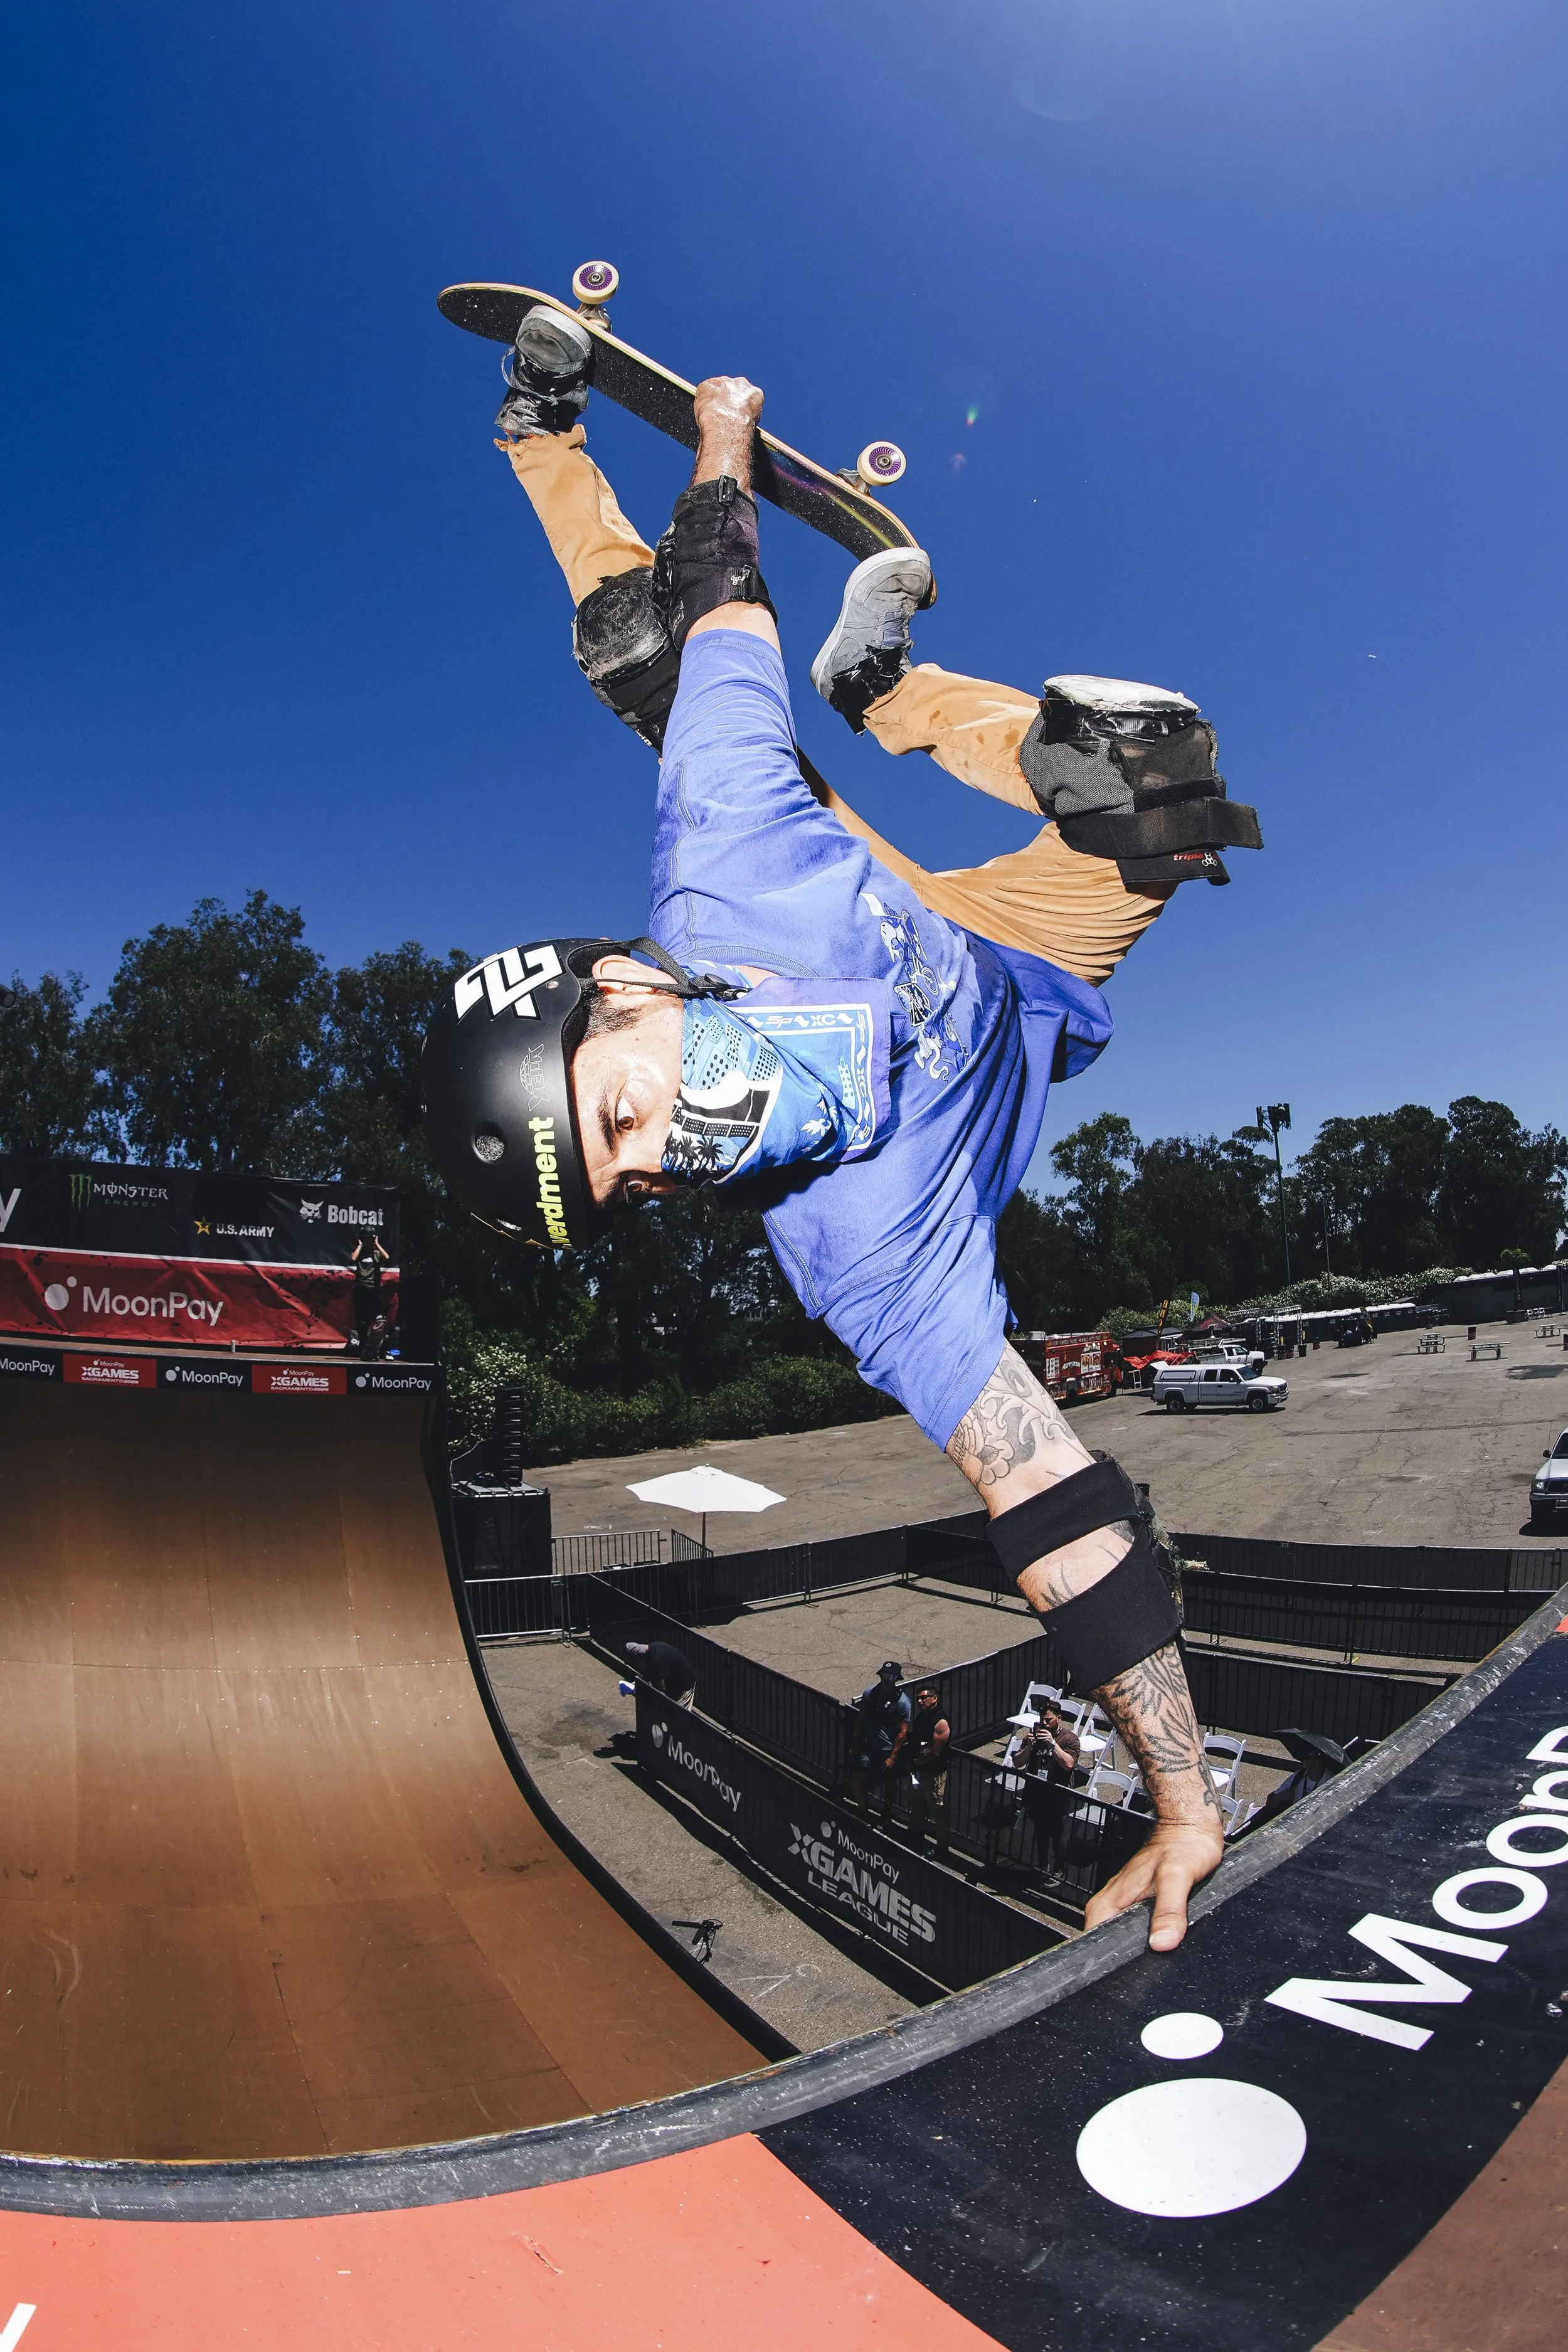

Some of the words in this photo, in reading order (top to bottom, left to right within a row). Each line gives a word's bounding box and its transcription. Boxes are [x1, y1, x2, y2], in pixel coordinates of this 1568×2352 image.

[93, 1182, 169, 1200] MONSTER
[528, 1116, 572, 1249] verdment
[105, 1199, 157, 1207] ENERGY
[327, 1205, 384, 1226] Bobcat
[216, 1223, 238, 1236] U.S.
[239, 1226, 275, 1237] ARMY
[83, 1286, 224, 1327] MoonPay
[0, 1358, 55, 1375] MoonPay
[182, 1370, 243, 1387] MoonPay
[372, 1377, 432, 1391] MoonPay
[838, 1829, 900, 1884] MoonPay
[807, 1870, 909, 1946] LEAGUE
